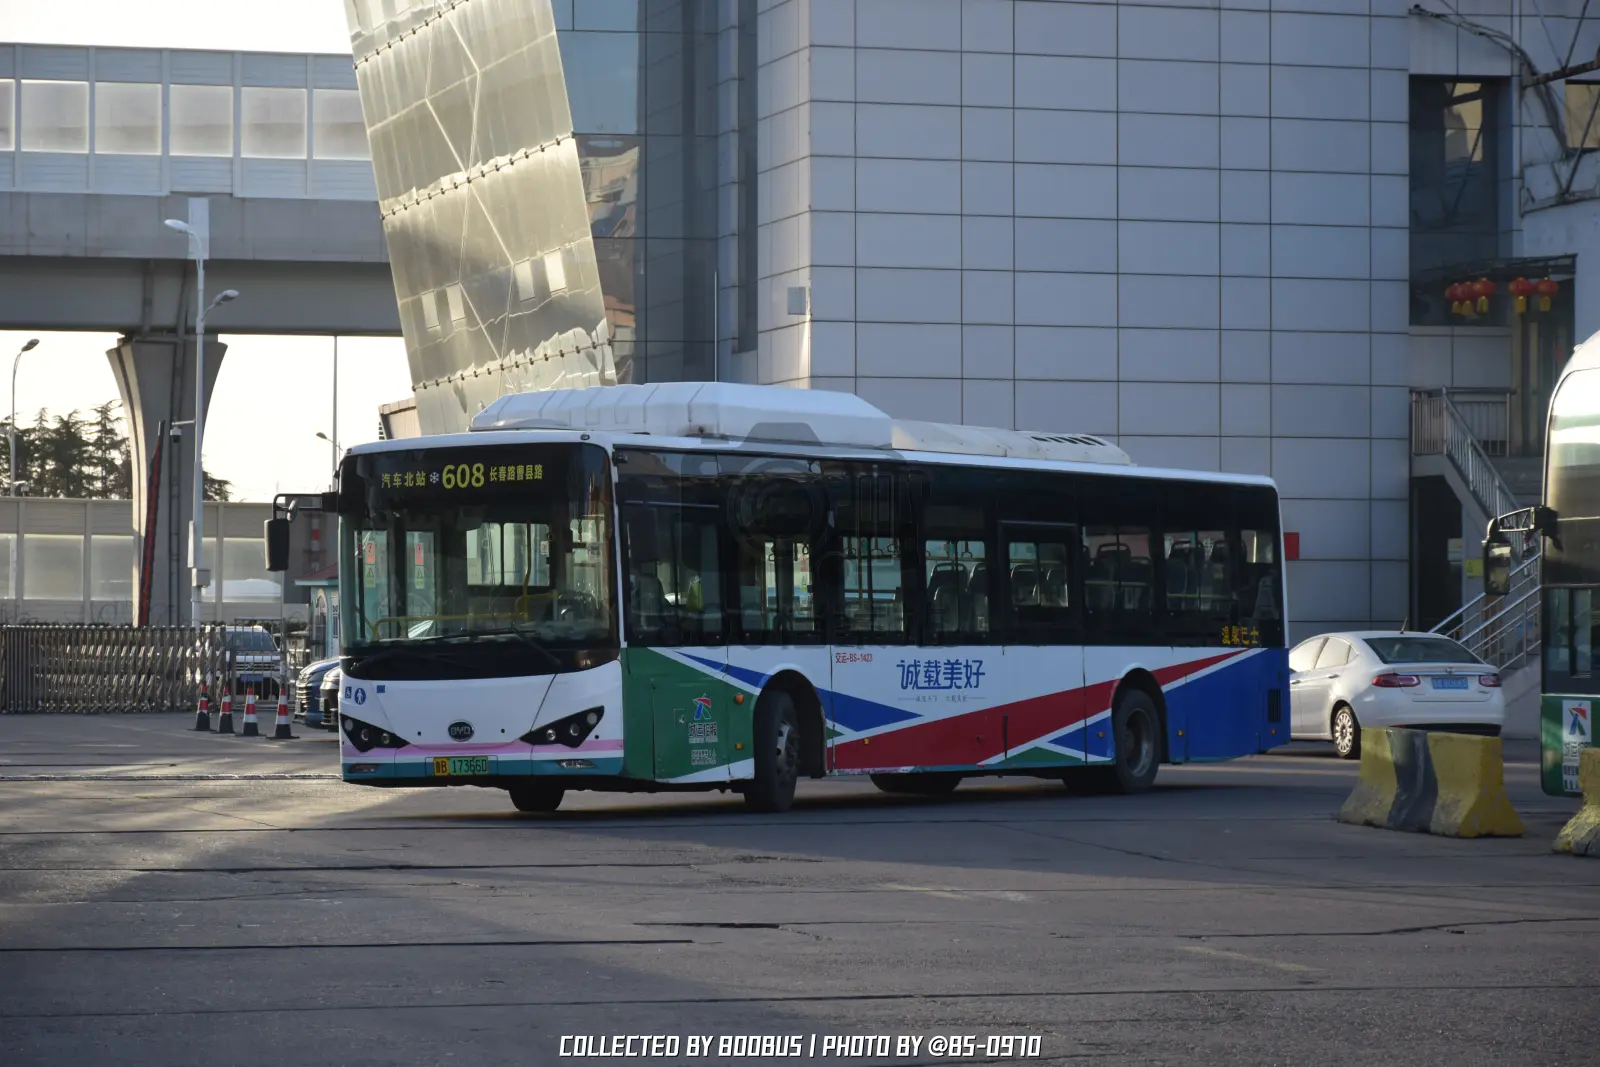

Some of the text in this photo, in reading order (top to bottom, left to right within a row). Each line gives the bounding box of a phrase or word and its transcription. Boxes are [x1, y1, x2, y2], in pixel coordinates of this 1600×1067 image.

[381, 463, 543, 489] 汽车北站 608 长春路曹县路
[896, 658, 986, 691] 诚载美好
